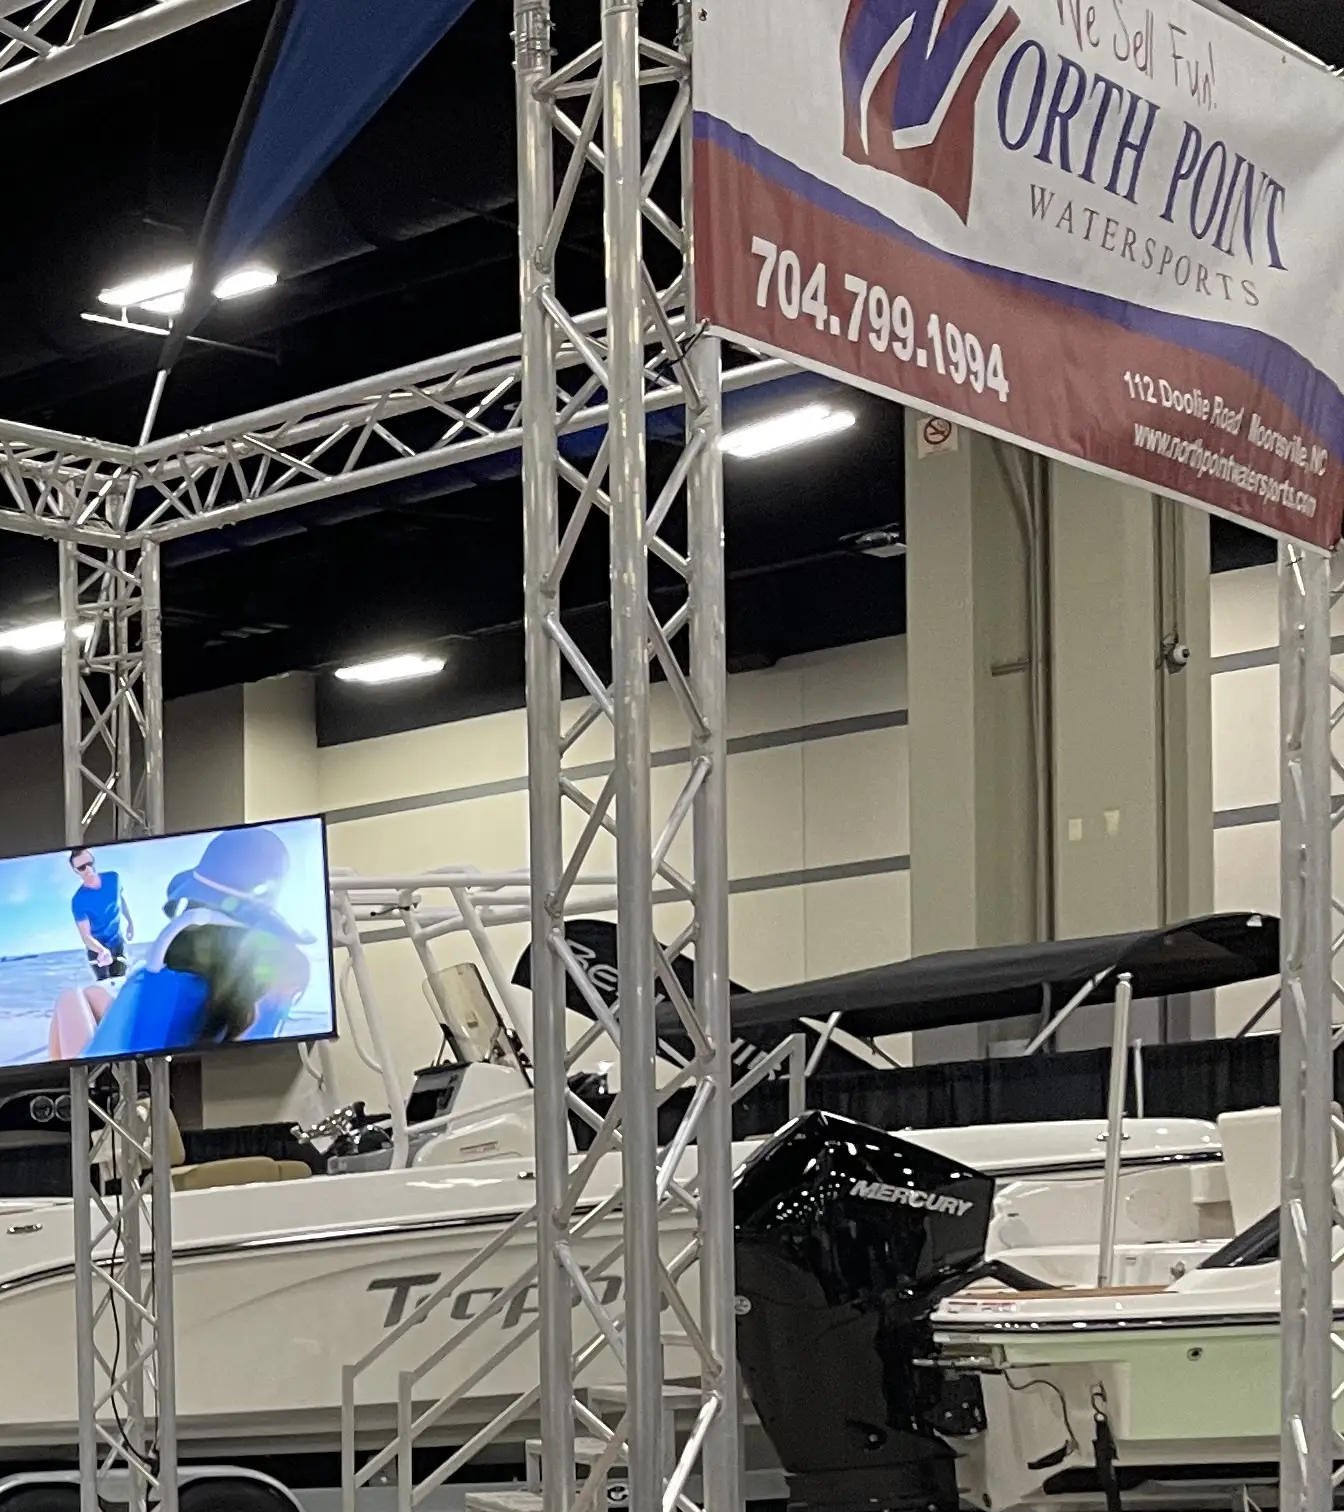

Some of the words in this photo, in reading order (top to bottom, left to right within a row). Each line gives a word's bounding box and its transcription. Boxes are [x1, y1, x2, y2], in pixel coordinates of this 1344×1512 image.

[1113, 0, 1154, 80] Sell
[1167, 21, 1218, 112] Fun!
[1029, 183, 1260, 307] WATERSPORTS
[1159, 120, 1288, 271] POINT
[751, 235, 1010, 402] 704.799.1994
[1123, 370, 1158, 404] 112
[1209, 395, 1245, 436] Road
[849, 1179, 974, 1217] MERCURY
